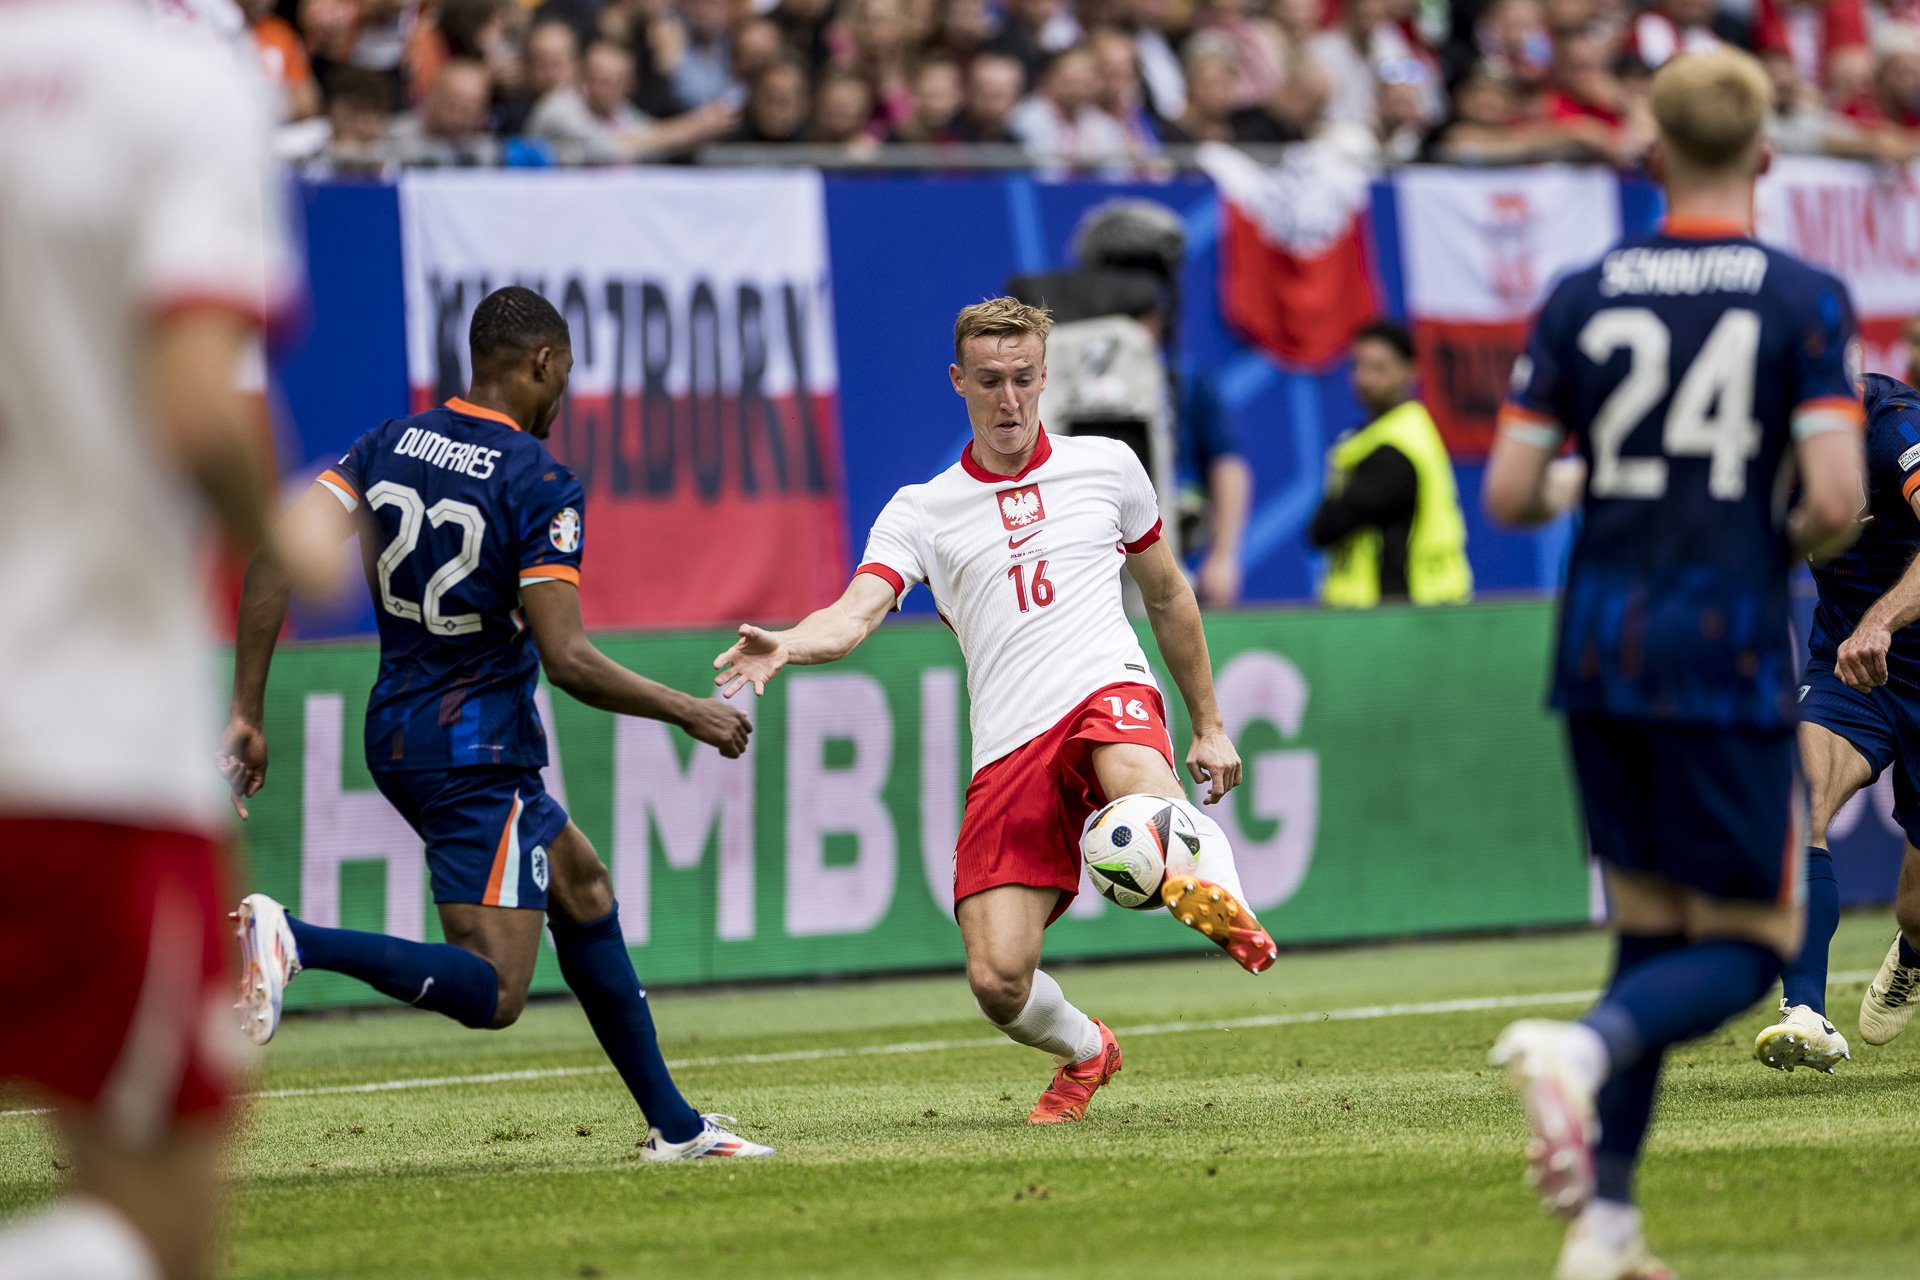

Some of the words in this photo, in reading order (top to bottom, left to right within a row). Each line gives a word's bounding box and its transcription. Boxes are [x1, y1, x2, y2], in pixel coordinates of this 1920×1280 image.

[393, 427, 502, 480] DUMFRIES
[1578, 308, 1763, 499] 24
[365, 480, 486, 636] 22
[1007, 559, 1056, 613] 16
[1103, 696, 1150, 722] 16
[301, 650, 1319, 950] HMBG
